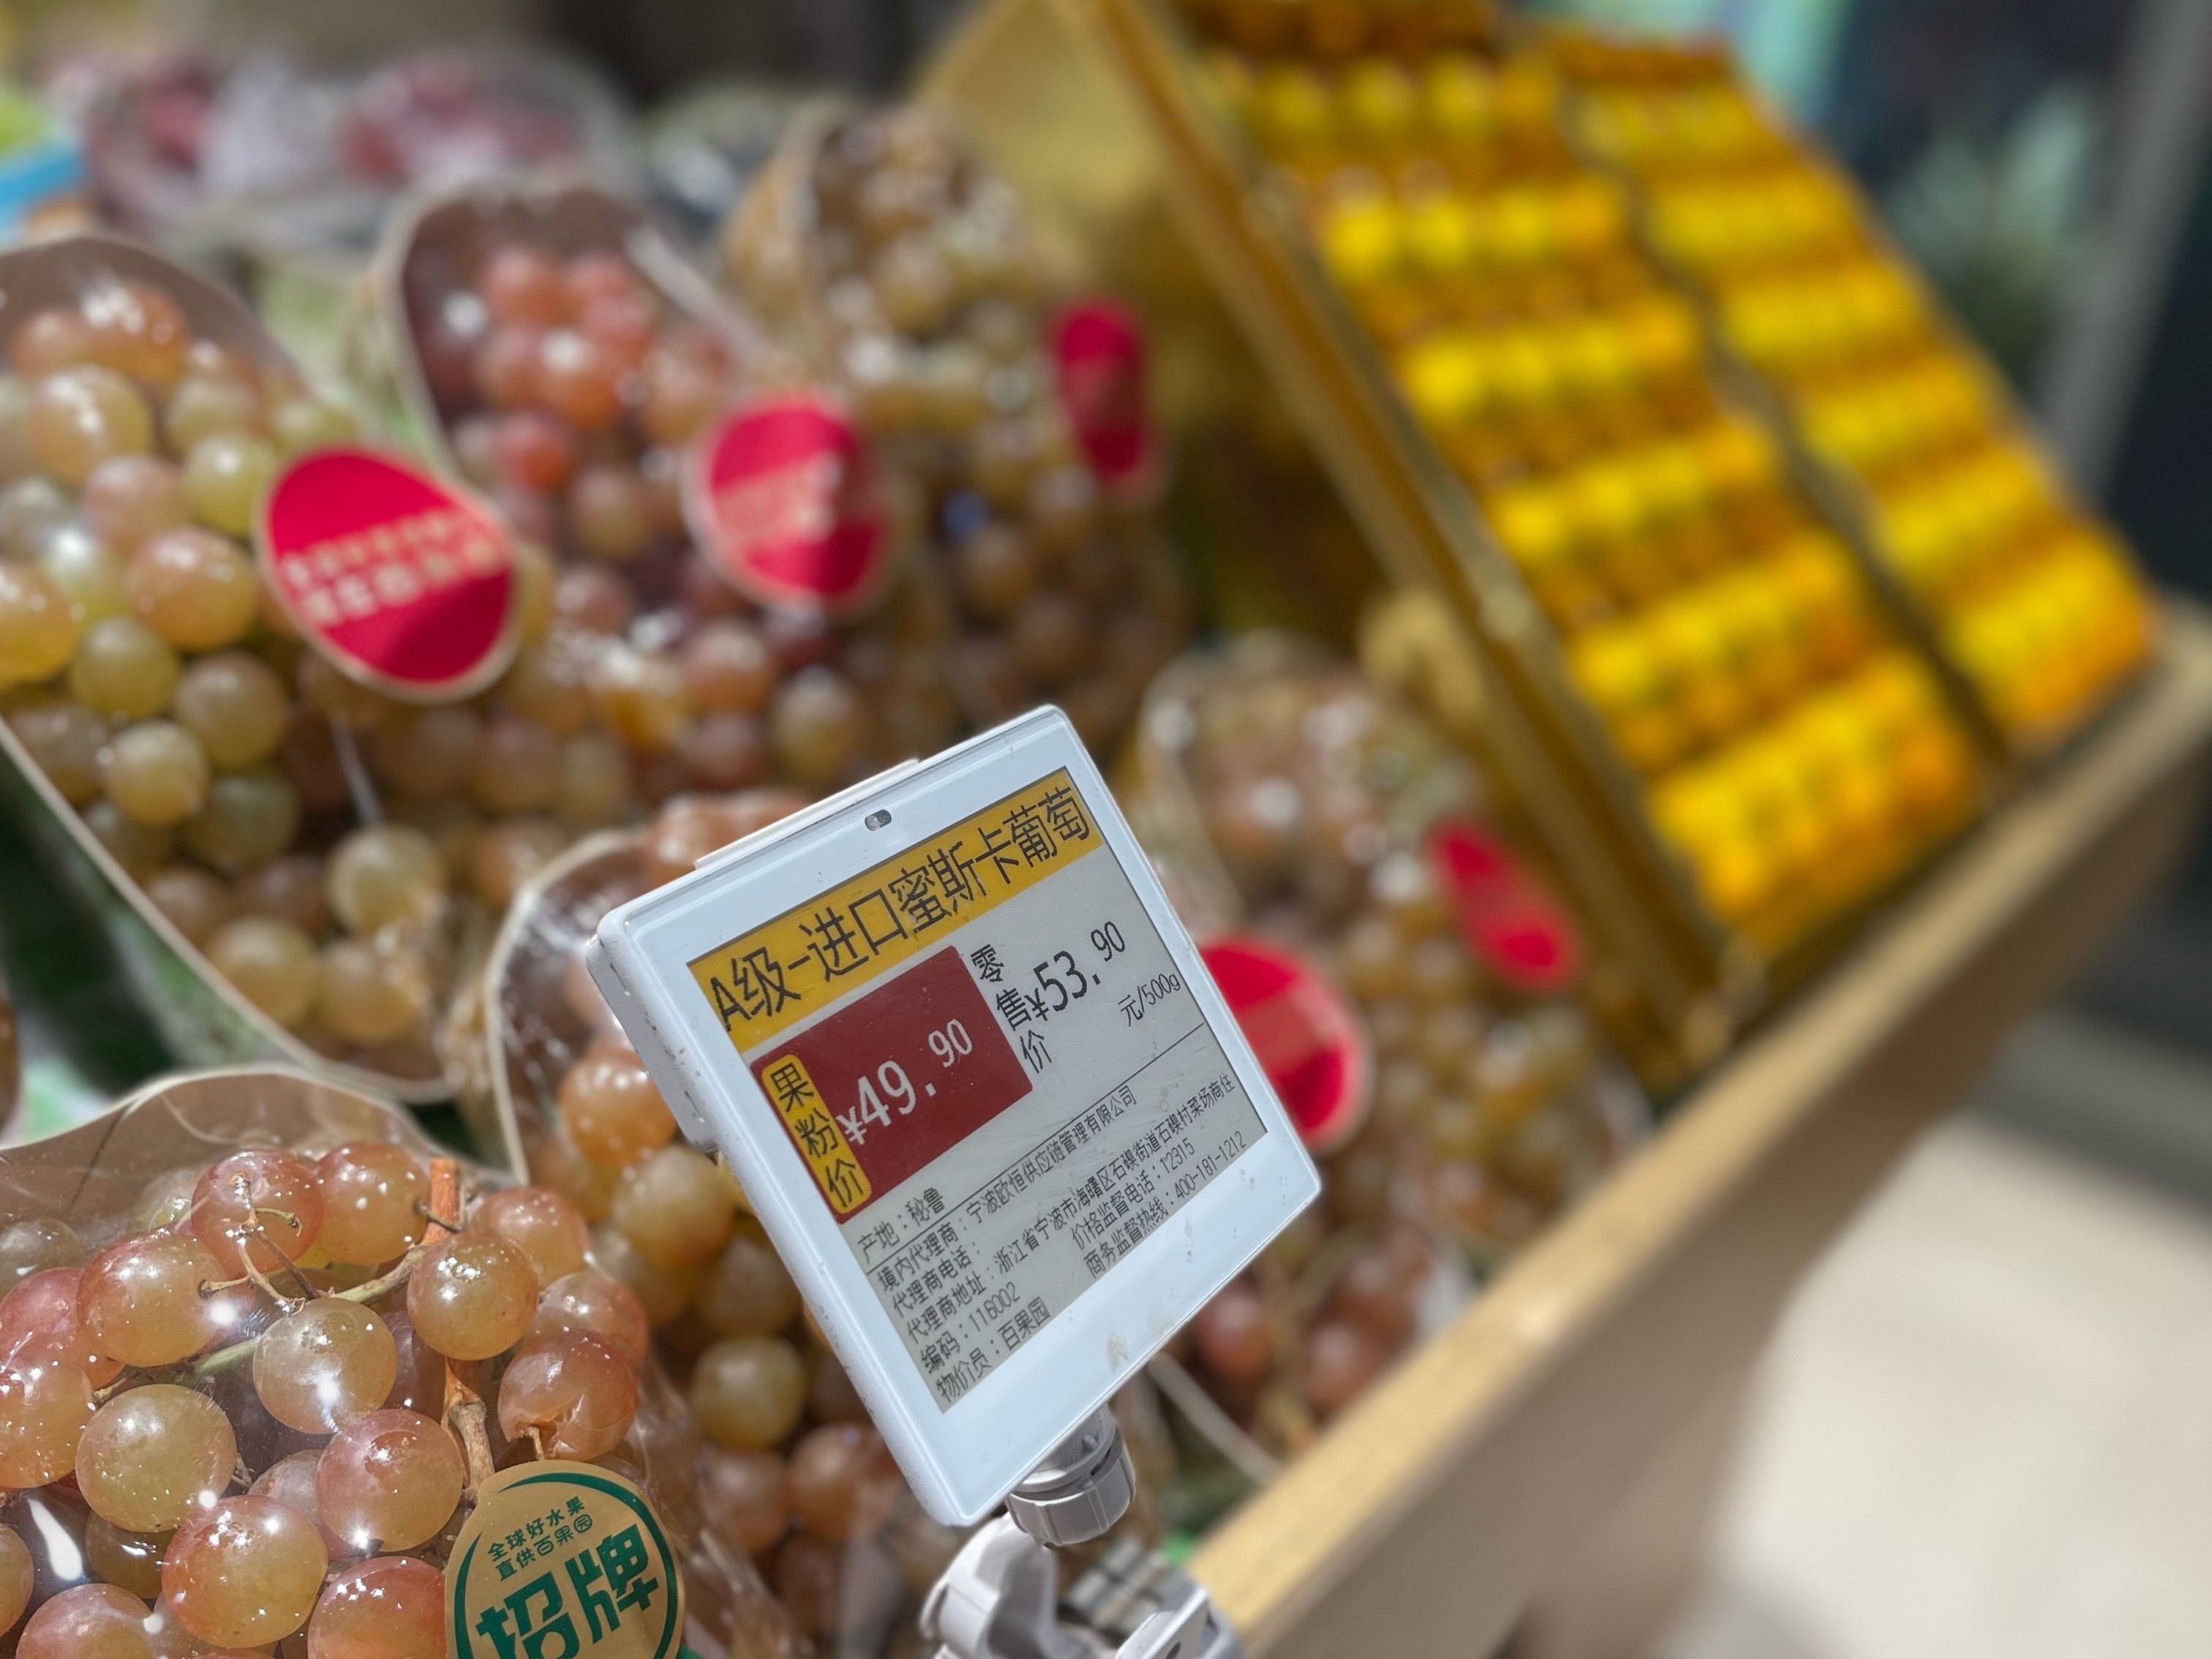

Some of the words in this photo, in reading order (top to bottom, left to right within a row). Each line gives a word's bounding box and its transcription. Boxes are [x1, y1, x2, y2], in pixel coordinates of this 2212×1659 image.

[710, 786, 1090, 1033] A级-进口蜜斯卡葡萄
[970, 944, 1052, 1074] 零售价
[1117, 973, 1181, 1027] 元/500g
[770, 1062, 864, 1208] 果粉价
[475, 1523, 660, 1659] 招牌
[487, 1496, 585, 1562] 全球好水果
[496, 1513, 593, 1581] 直供百果园
